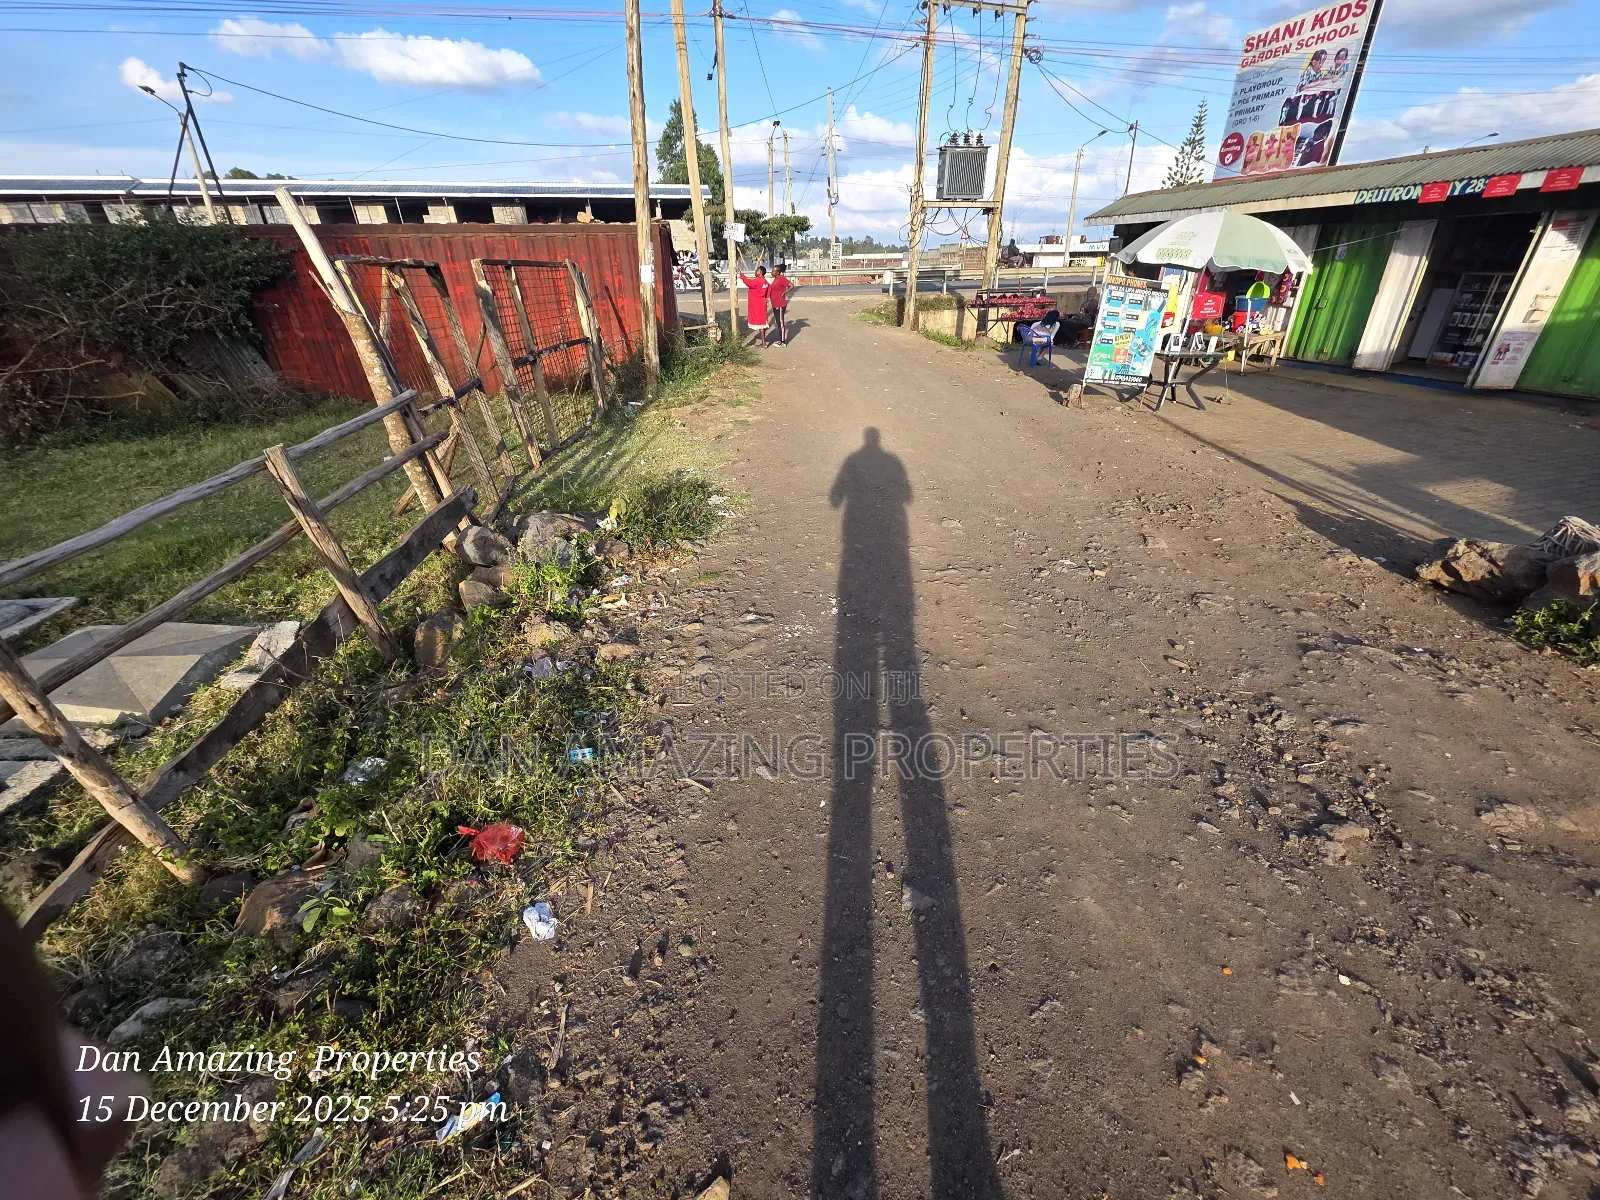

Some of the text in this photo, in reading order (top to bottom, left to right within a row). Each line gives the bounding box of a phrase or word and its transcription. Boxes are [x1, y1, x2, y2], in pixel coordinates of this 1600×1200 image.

[1243, 0, 1368, 53] SHANI KIDS
[1240, 23, 1359, 68] GARDEN SCHOOL
[1239, 77, 1283, 95] PLAYGROUP
[1237, 87, 1287, 107] PRE PRIMARY
[1234, 103, 1266, 117] PRIMARY
[1465, 177, 1489, 194] 28:
